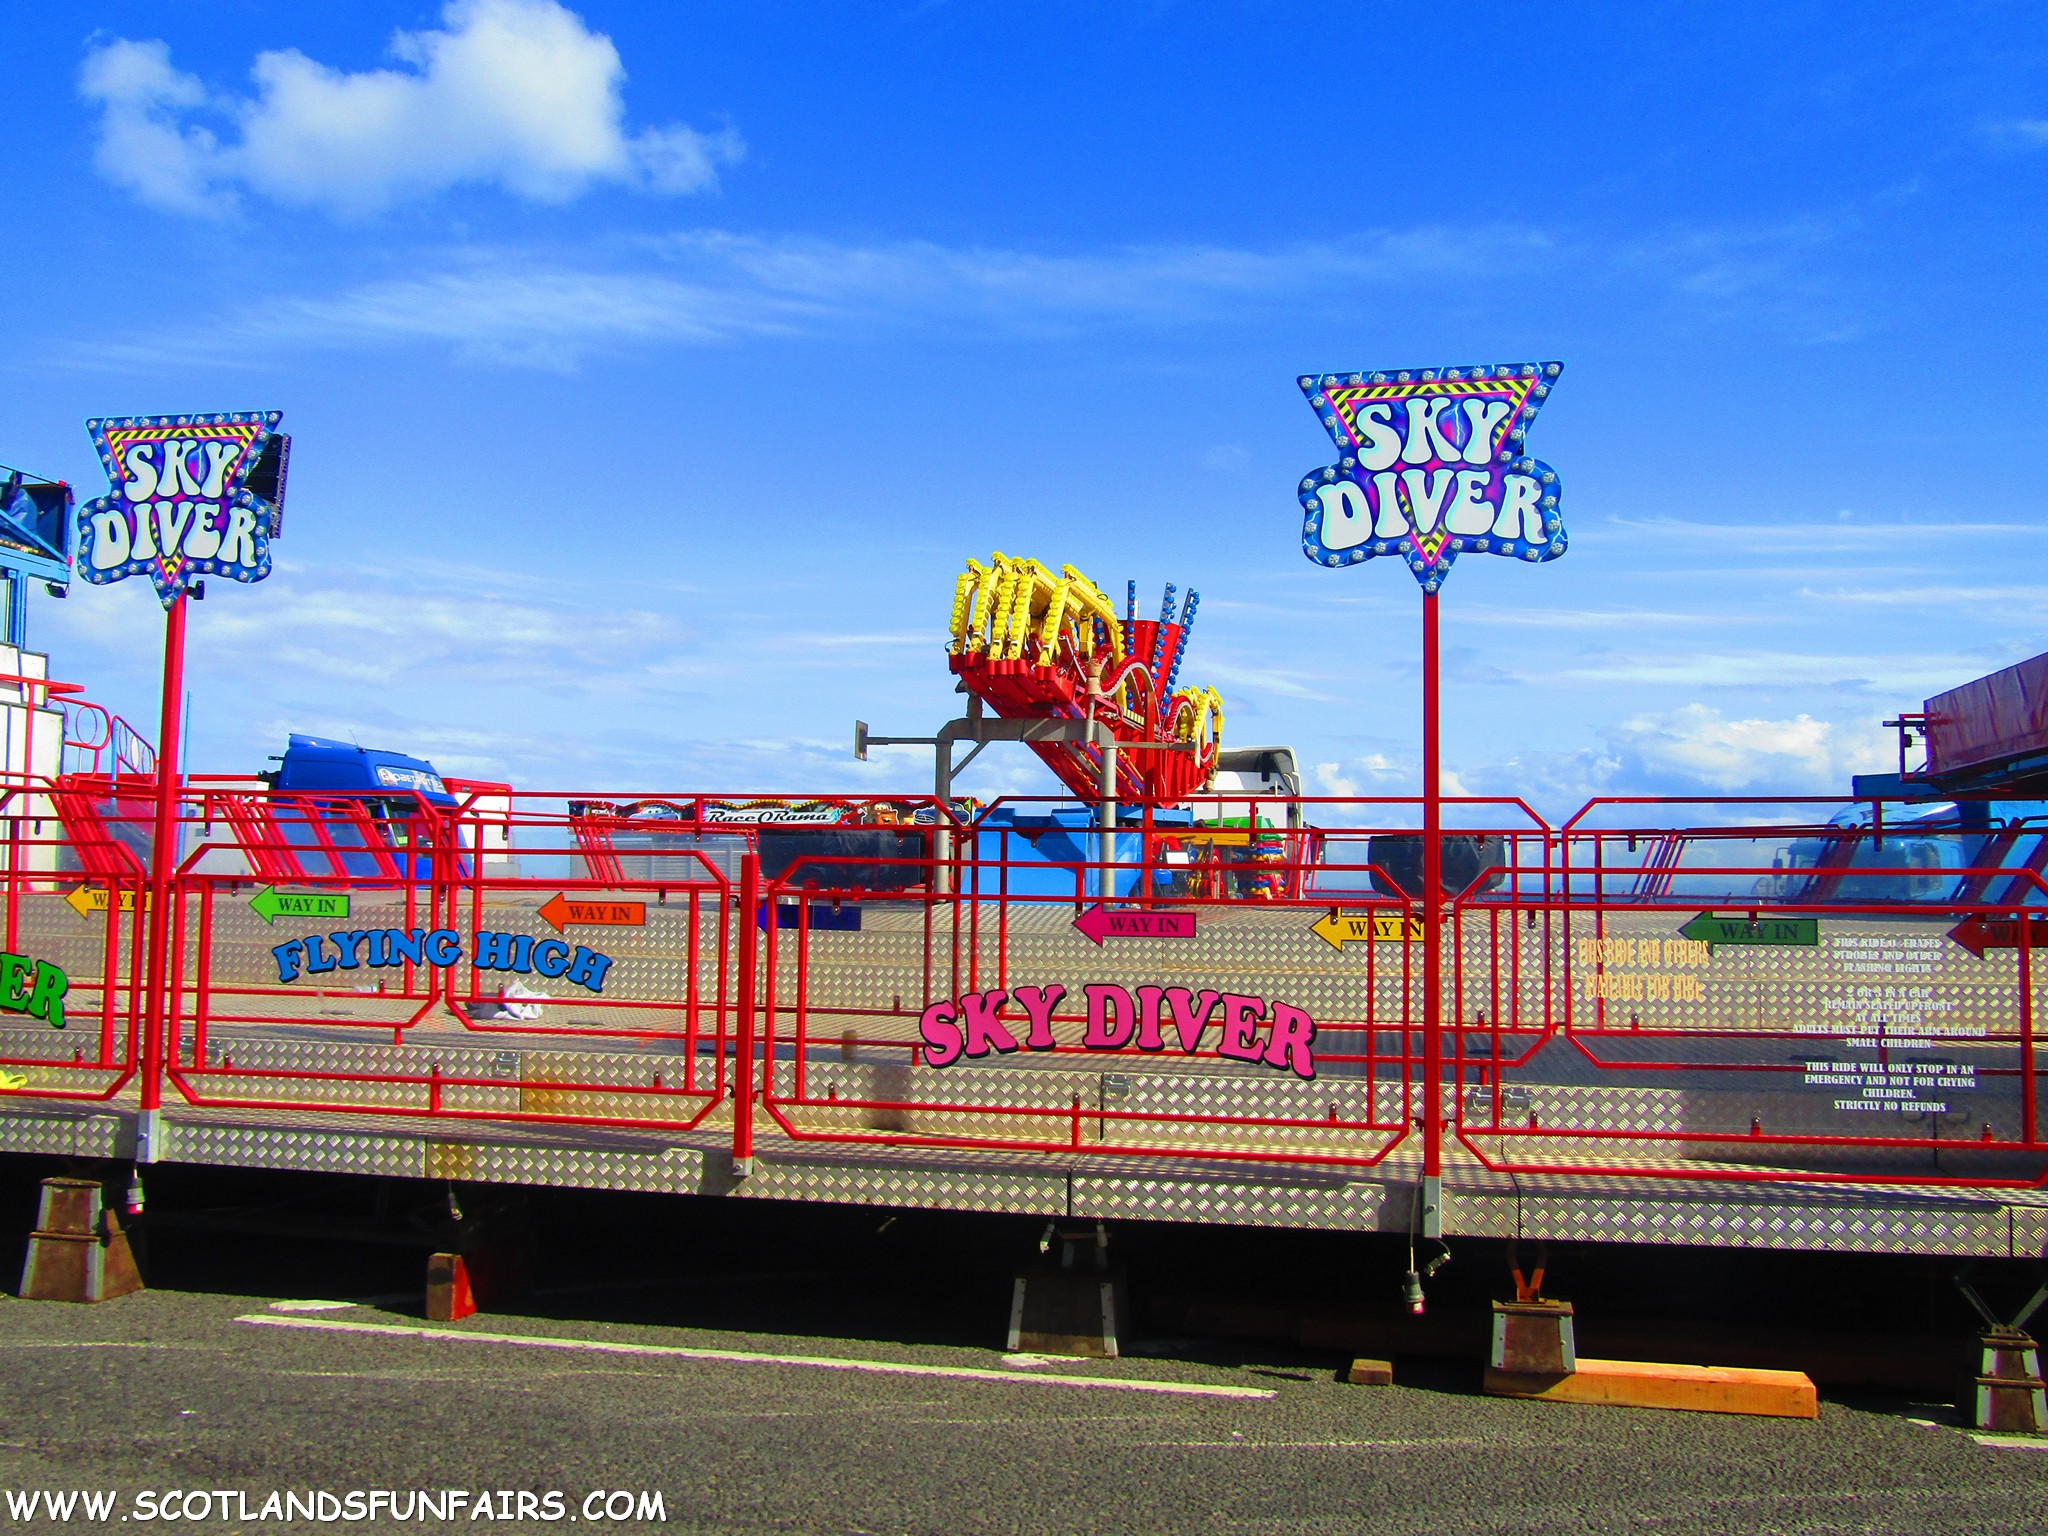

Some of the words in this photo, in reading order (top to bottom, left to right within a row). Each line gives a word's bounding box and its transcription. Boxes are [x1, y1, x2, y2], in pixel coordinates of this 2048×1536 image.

[1356, 397, 1510, 471] SKY
[124, 439, 240, 502] SKY
[1316, 469, 1548, 551] DIVER
[90, 500, 258, 570] DIVER
[278, 897, 314, 912] WAY
[318, 899, 336, 913] IN
[569, 906, 606, 920] WAY
[611, 907, 631, 920] IN
[1109, 917, 1152, 932] WAY
[1157, 918, 1180, 932] IN
[1719, 923, 1767, 939] WAY
[1773, 924, 1799, 940] IN
[1860, 938, 1886, 948] RIDE
[272, 928, 462, 983] FLYING
[472, 931, 613, 993] HIGH
[1825, 1001, 1862, 1010] REMAIN
[1855, 1013, 1867, 1022] AT
[1870, 1013, 1889, 1023] ALL
[1893, 1014, 1922, 1023] TIMES
[919, 984, 1067, 1069] SKY
[1082, 983, 1317, 1081] DIVER
[1792, 1024, 1829, 1034] ADULTS
[1860, 1025, 1879, 1035] PUT
[1884, 1026, 1916, 1036] THEIR
[1918, 1027, 1942, 1036] ARM
[1944, 1027, 1986, 1037] AROUND
[1846, 1038, 1878, 1048] SMALL
[1880, 1038, 1931, 1048] CHILDREN
[1805, 1062, 1829, 1072] THIS
[1832, 1062, 1857, 1073] RIDE
[1860, 1062, 1885, 1073] WILL
[1887, 1063, 1913, 1074] ONLY
[1916, 1064, 1943, 1074] STOP
[1946, 1065, 1957, 1074] IN
[1960, 1065, 1974, 1075] AN
[1804, 1075, 1862, 1085] EMERGENCY
[1865, 1076, 1886, 1085] AND
[1889, 1076, 1910, 1086] NOT
[1913, 1077, 1935, 1086] FOR
[1937, 1078, 1975, 1087] CRYING
[1862, 1088, 1917, 1099] CHILDREN.
[1834, 1100, 1880, 1111] STRICTLY
[1883, 1101, 1898, 1111] NO
[1901, 1101, 1947, 1112] REFUNDS
